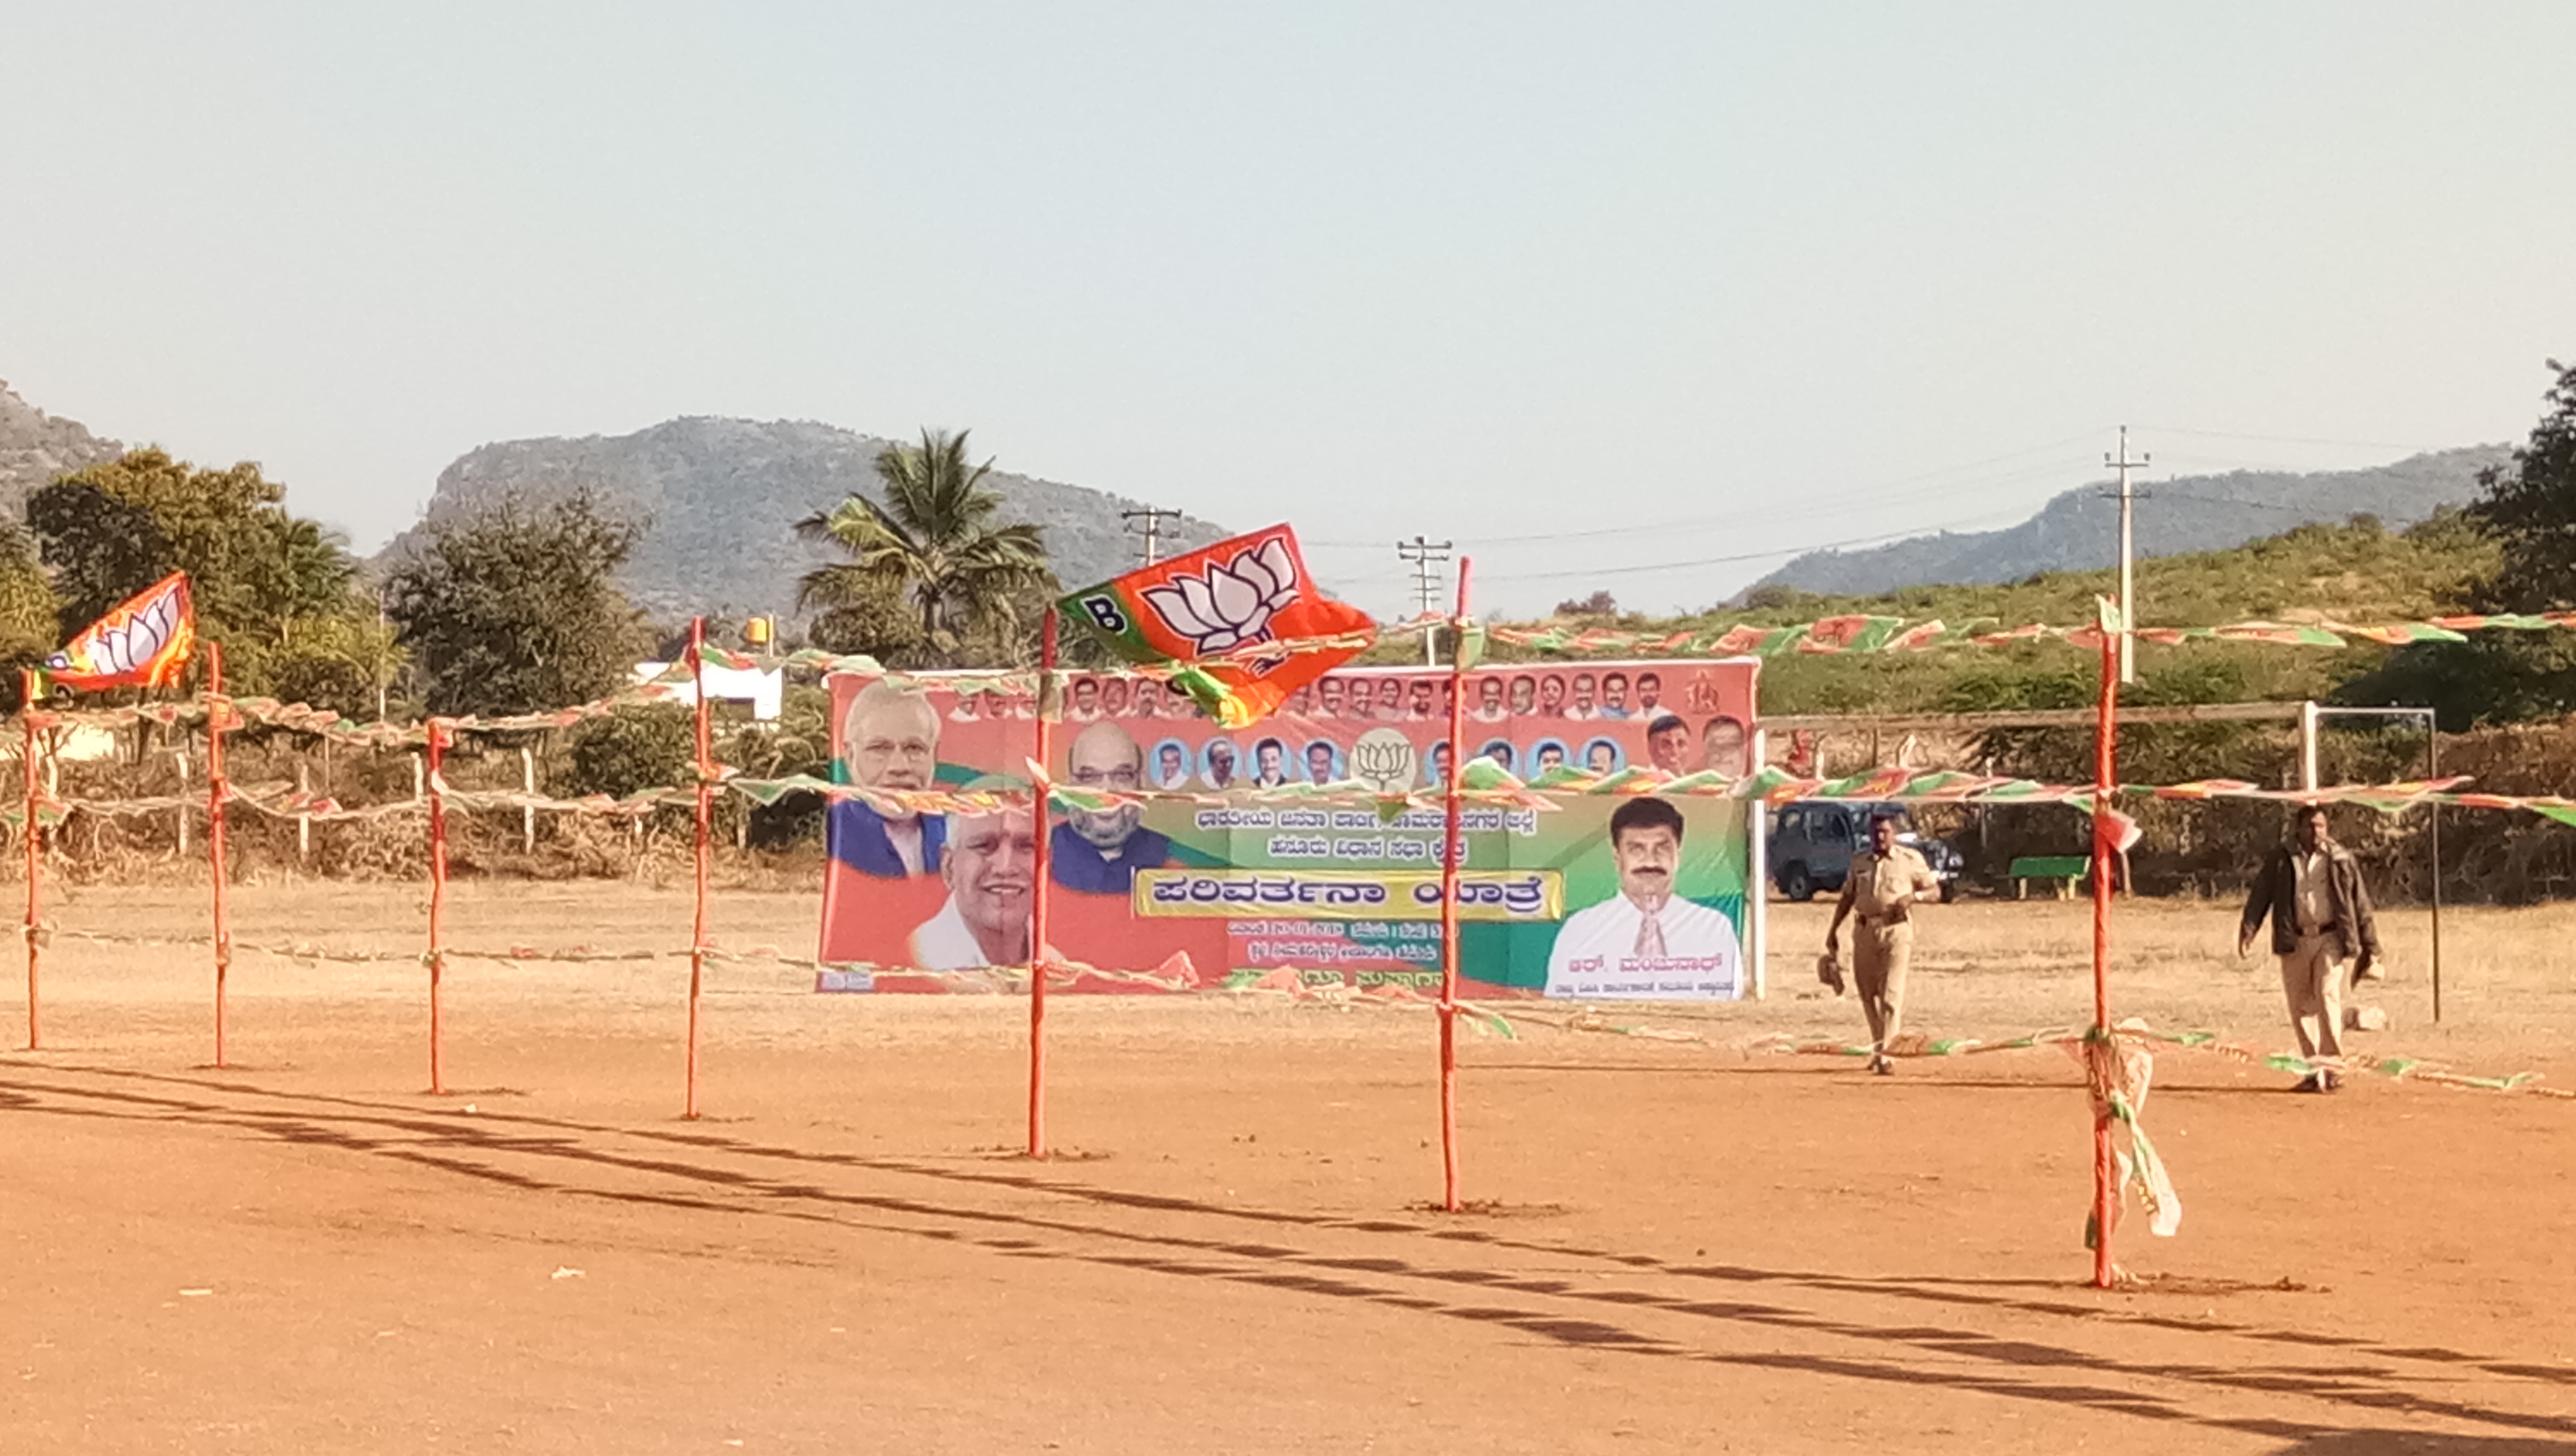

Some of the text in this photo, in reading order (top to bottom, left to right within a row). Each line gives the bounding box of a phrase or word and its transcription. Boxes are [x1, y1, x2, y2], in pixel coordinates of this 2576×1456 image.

[1198, 809, 1272, 828] ಭಾರತೀಯ
[1280, 810, 1327, 827] ಜನತಾ
[1271, 836, 1328, 856] ಹನೂರು
[1335, 837, 1382, 856] ವಿಧಾನ
[1390, 839, 1424, 857] ಸಭಾ
[1152, 875, 1543, 911] ಪರಿವರ್ತನಾ ಯಾತ್ರೆ
